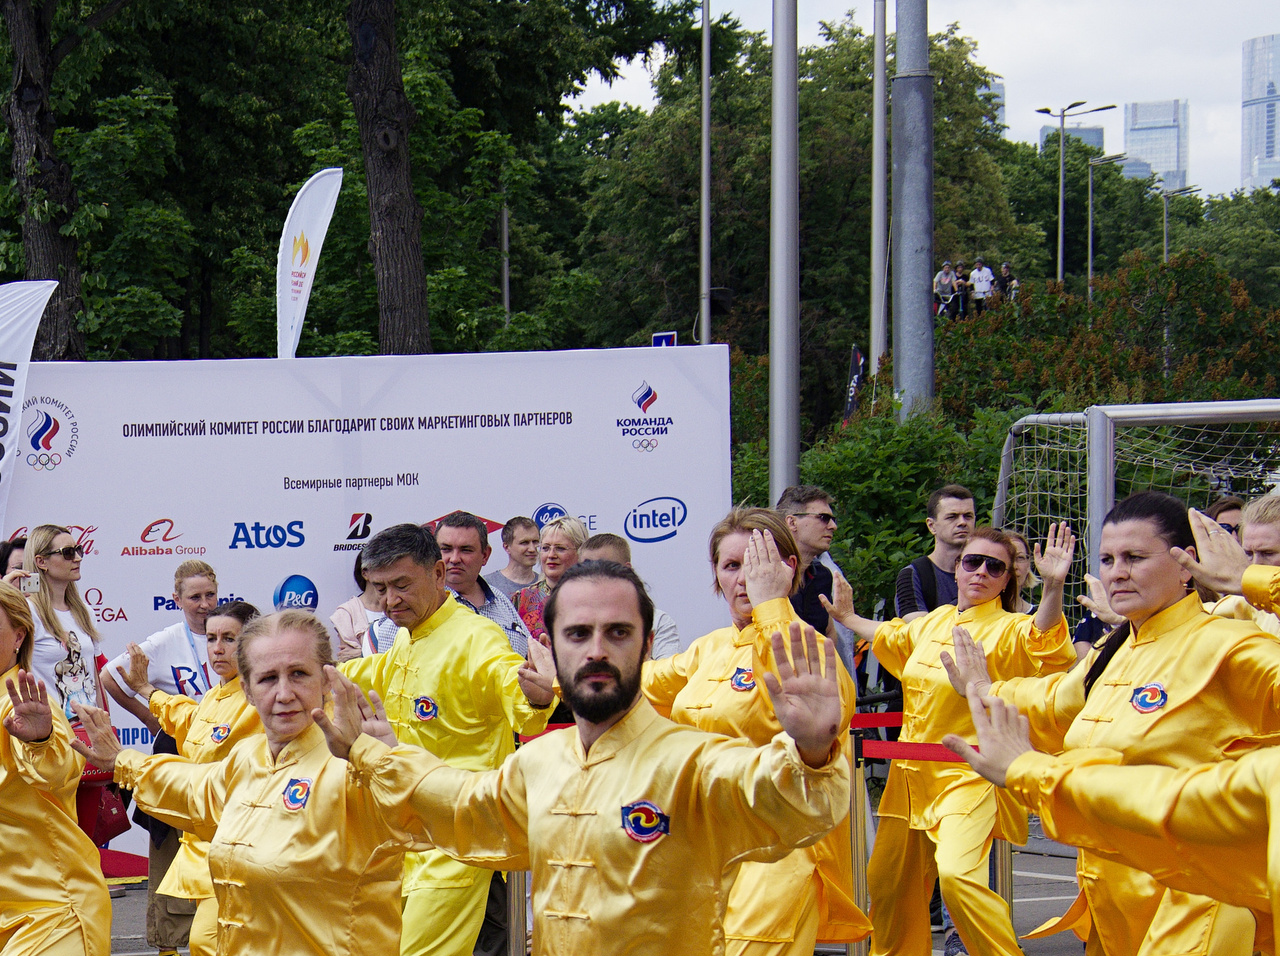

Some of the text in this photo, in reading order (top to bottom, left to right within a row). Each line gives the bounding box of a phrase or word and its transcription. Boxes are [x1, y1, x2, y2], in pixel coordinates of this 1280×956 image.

[40, 396, 75, 420] КОМИТЕТ
[65, 421, 79, 458] РОССИИ
[122, 411, 573, 437] ОЛИМПИЙСКИЙ КОМИТЕТ РОССИИ БЛАГОДАРИТ СВОИХ МАРКЕТИНГОВЫХ ПАРТНЕРОВ
[616, 417, 673, 427] КОМАНДА
[622, 427, 668, 436] РОССИИ
[284, 473, 419, 491] Всемирные партнеры МОК
[632, 506, 676, 529] intel
[120, 545, 206, 556] Alibaba Group
[333, 543, 366, 552] BRIDGES
[283, 590, 314, 607] P&G
[94, 607, 128, 622] EGA
